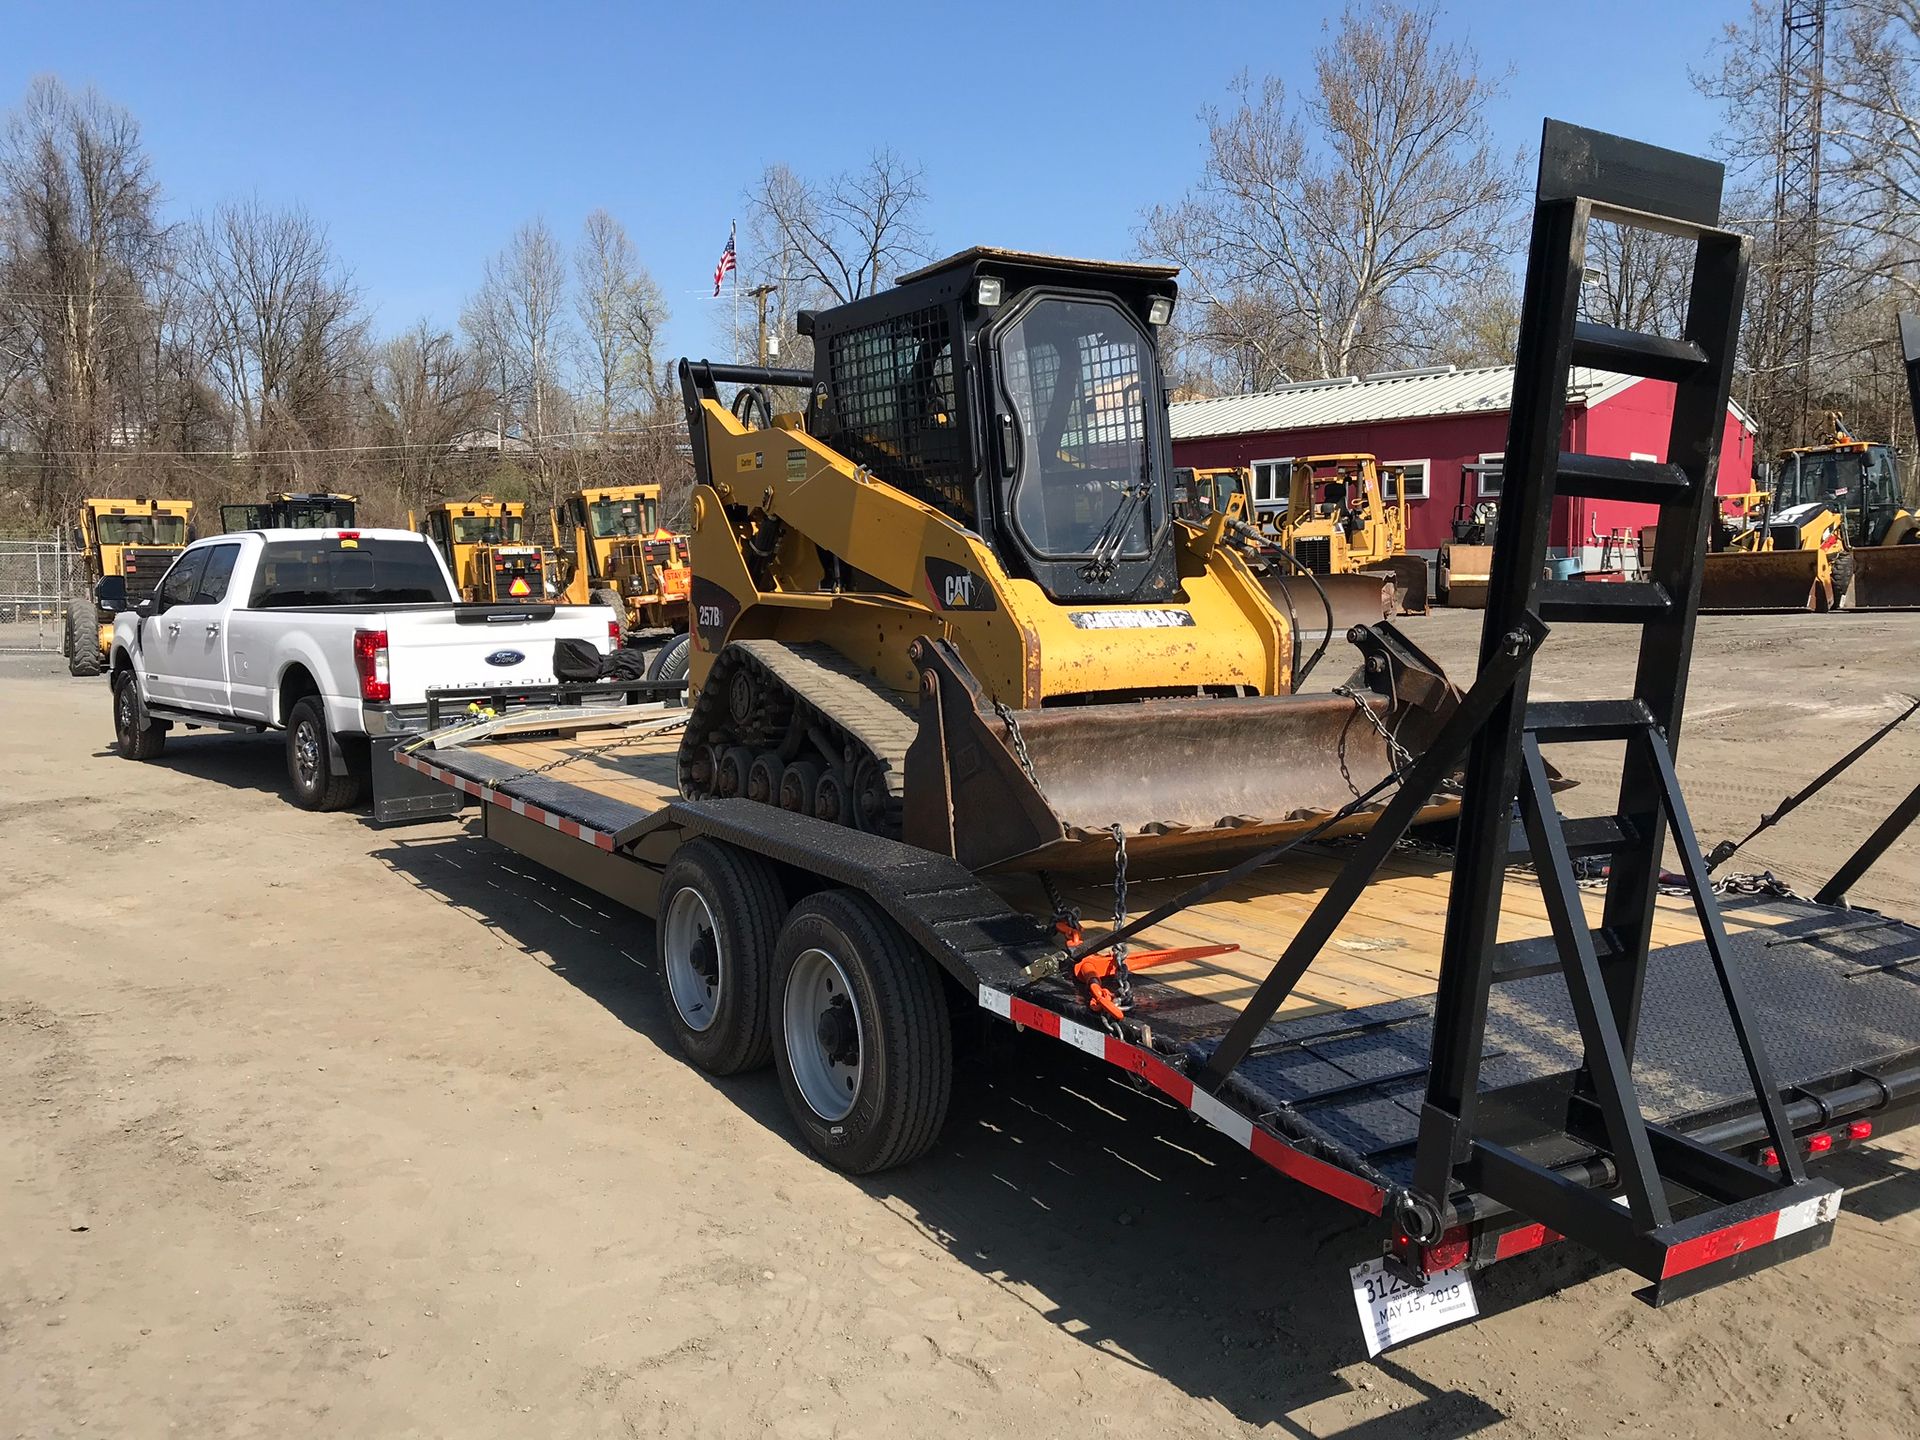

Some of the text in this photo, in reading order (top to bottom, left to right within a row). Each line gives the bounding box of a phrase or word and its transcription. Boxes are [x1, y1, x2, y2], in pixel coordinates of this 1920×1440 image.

[945, 575, 971, 606] CAT
[699, 605, 720, 627] 257B
[1379, 1302, 1403, 1325] MAY
[1407, 1297, 1426, 1313] 15,
[1428, 1284, 1460, 1306] 2019
